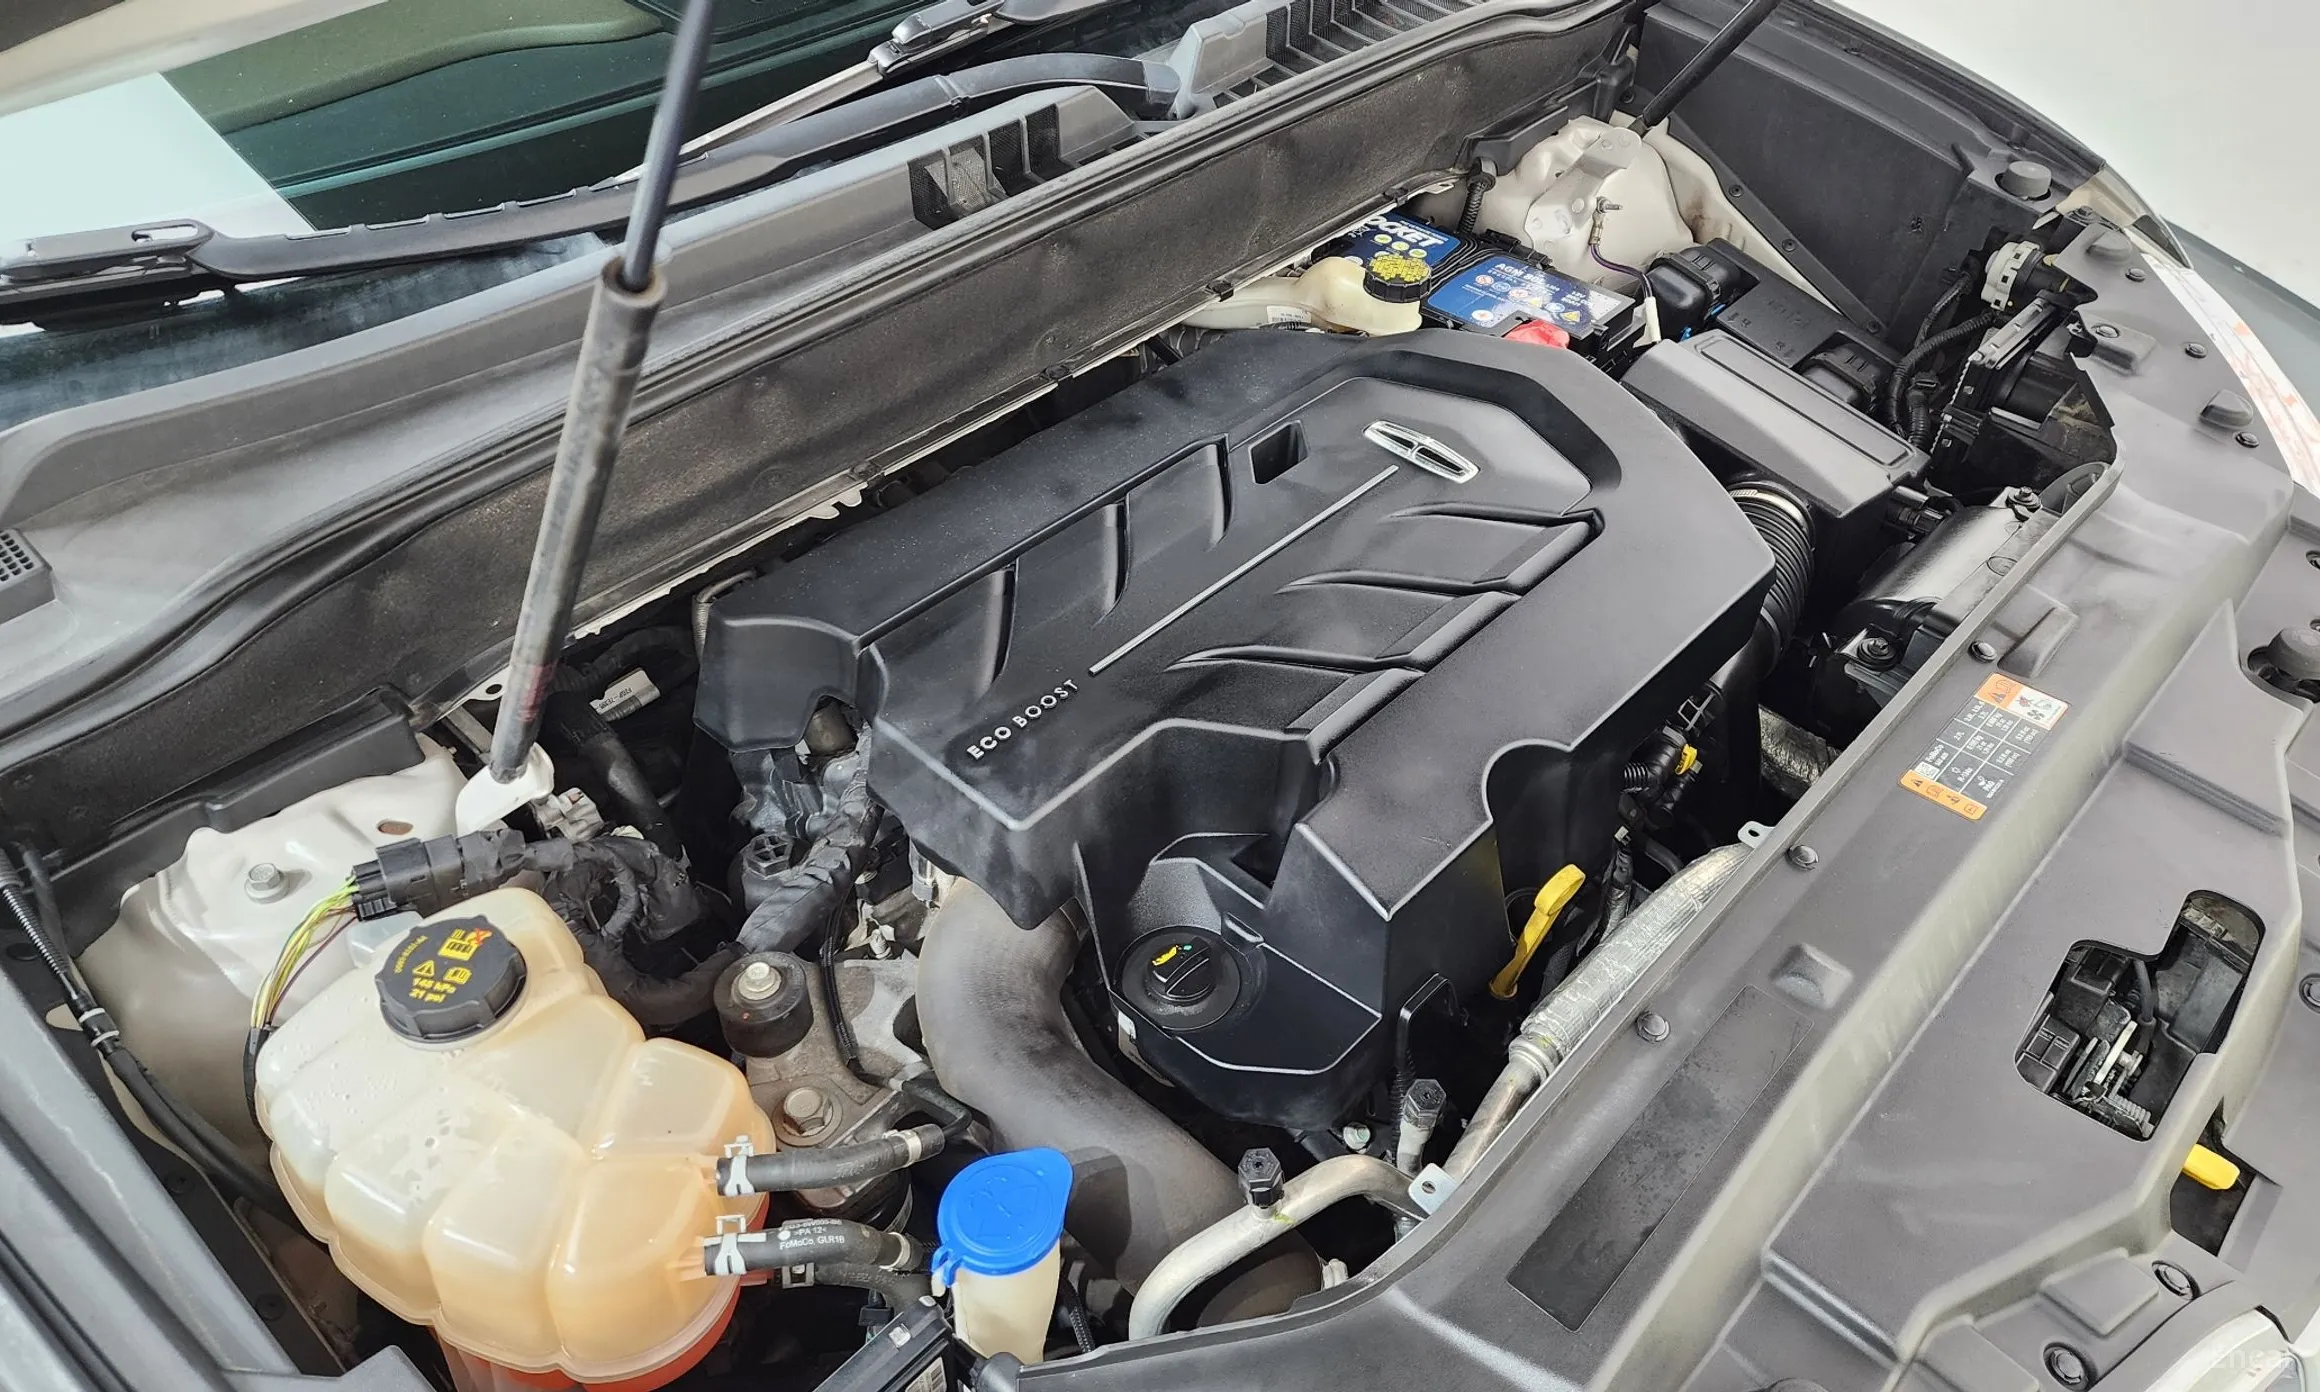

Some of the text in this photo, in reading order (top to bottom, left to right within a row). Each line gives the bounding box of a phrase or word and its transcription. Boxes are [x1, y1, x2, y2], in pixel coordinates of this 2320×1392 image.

[1364, 215, 1445, 248] OCKET
[966, 679, 1078, 760] ECO BOOST
[779, 1237, 817, 1250] FoMoCo,
